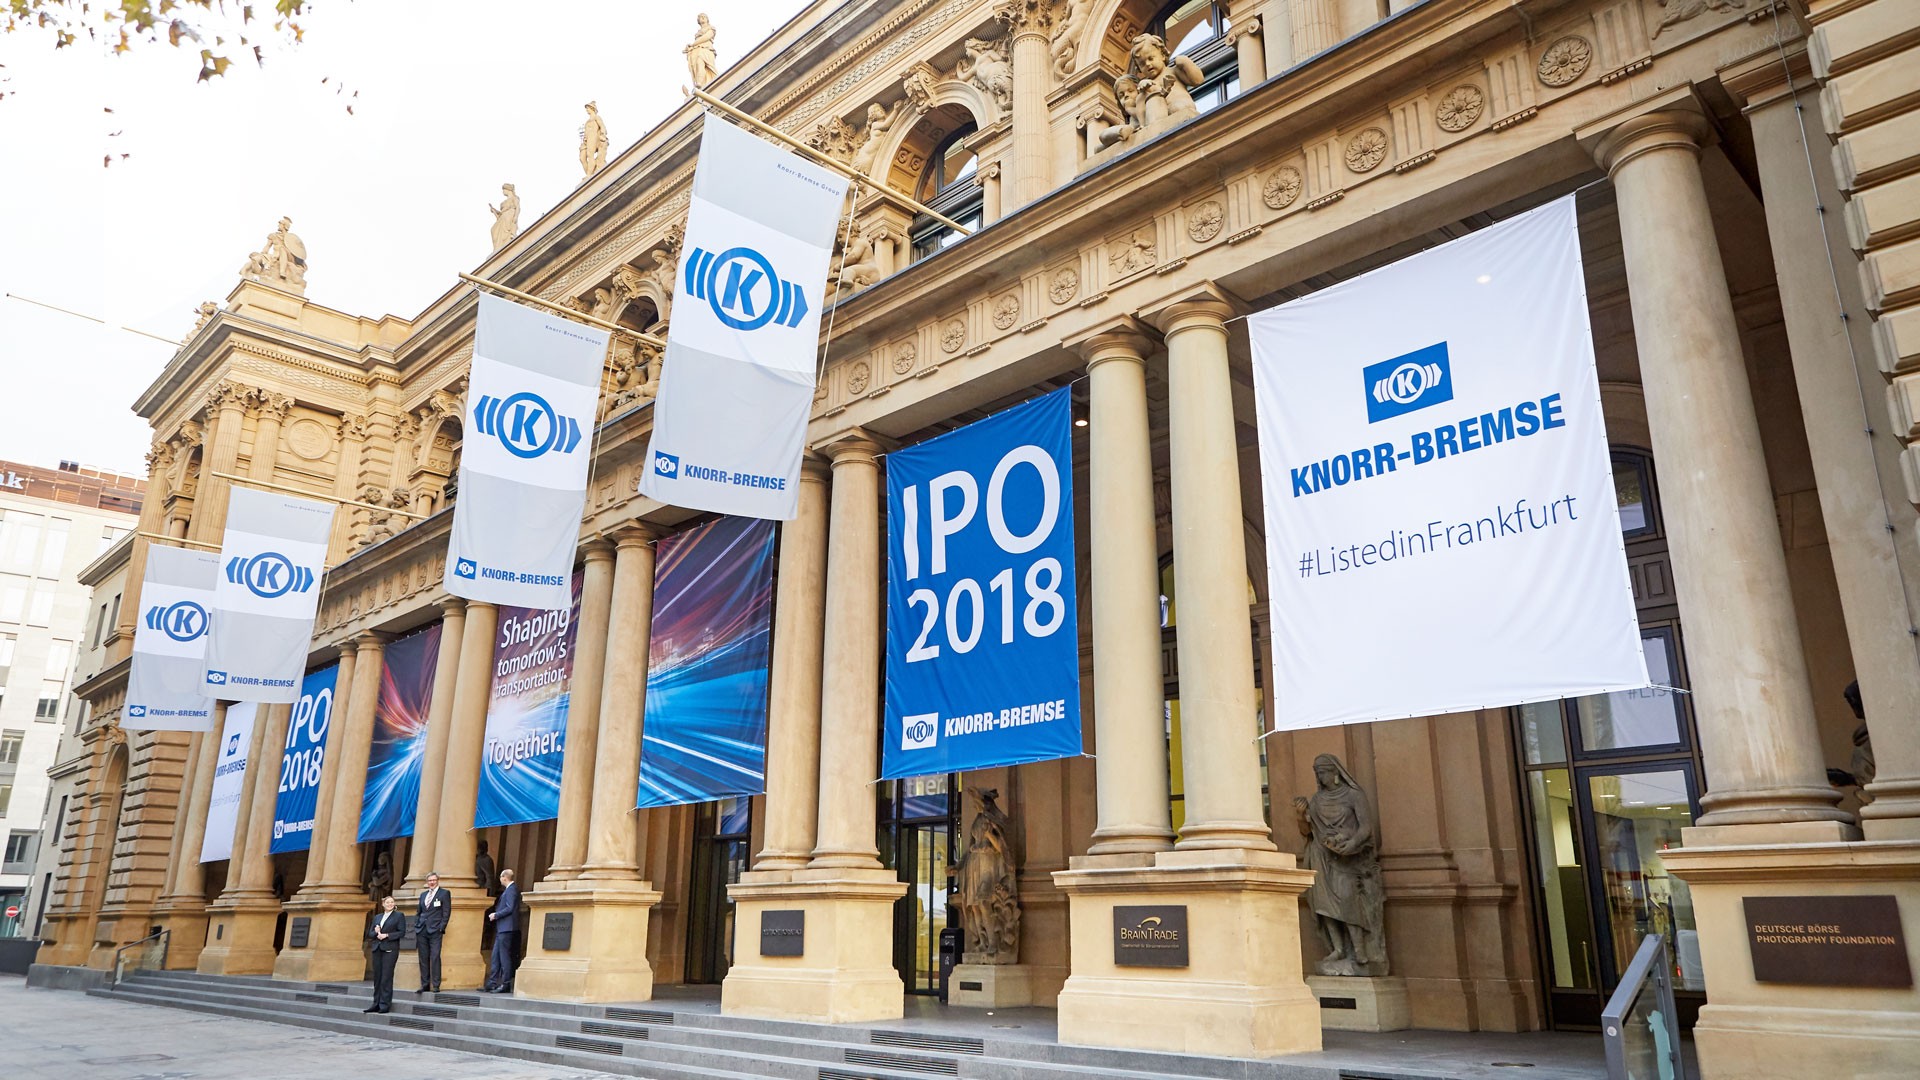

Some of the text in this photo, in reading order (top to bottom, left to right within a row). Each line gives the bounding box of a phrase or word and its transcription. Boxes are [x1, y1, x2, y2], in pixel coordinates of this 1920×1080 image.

[777, 163, 840, 196] Knorr-Bremse Group
[1290, 392, 1566, 498] KNORR-BREMSE
[684, 464, 787, 491] KNORR-BREMSE
[902, 444, 1061, 581] IPO
[1298, 494, 1578, 579] #ListedinFrankfurt
[481, 567, 564, 586] KNORR-BREMSE
[500, 609, 571, 649] Shaping
[905, 556, 1066, 664] 2018
[497, 637, 568, 677] tomorrow's
[230, 675, 296, 688] KNORR-BREMSE
[495, 667, 568, 699] transportation.
[149, 708, 208, 717] KNORR-BREMSE
[285, 687, 333, 750] IPO
[944, 699, 1065, 738] KNORR-BREMSE
[278, 745, 324, 793] 2018
[488, 729, 563, 770] Together.
[1754, 923, 1841, 934] DEUTSCHE BÖRSE
[1756, 935, 1896, 945] PHOTOGRAPHY FOUNDATION
